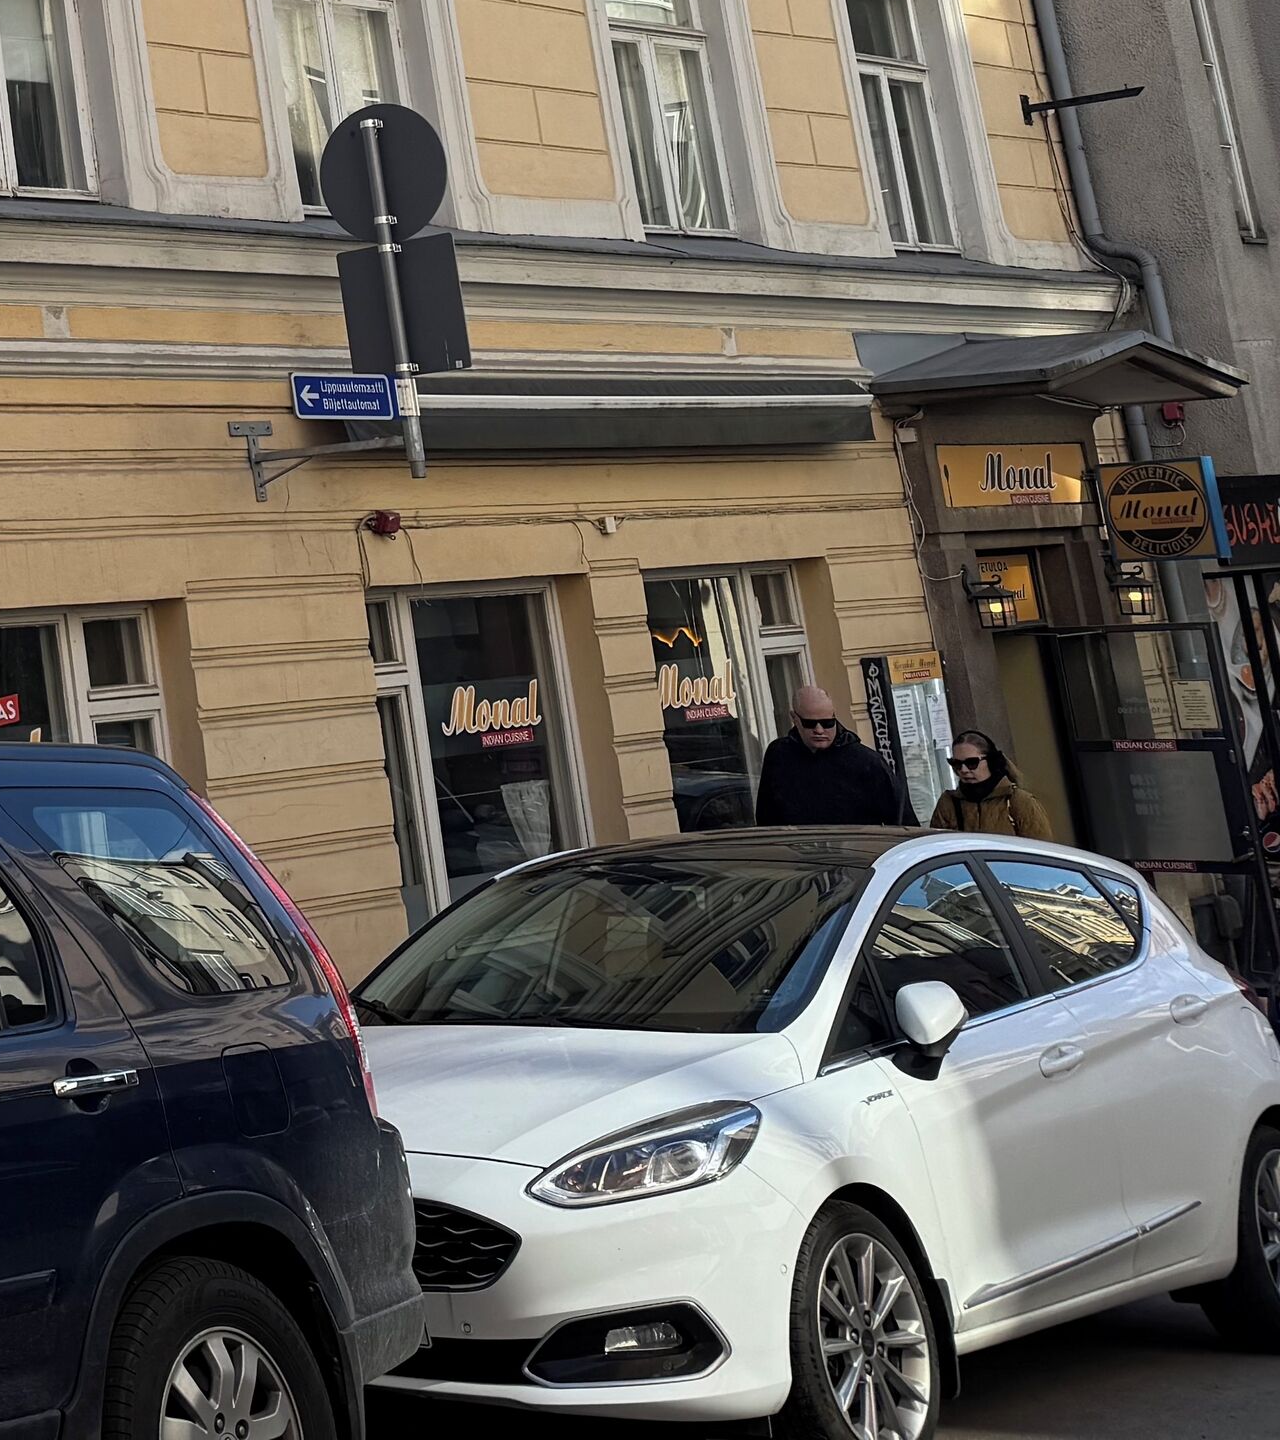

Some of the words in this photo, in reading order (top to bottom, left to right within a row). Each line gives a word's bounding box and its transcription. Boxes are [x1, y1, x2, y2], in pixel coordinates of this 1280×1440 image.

[320, 380, 384, 395] Lippuautomaatti
[322, 398, 381, 412] Biljettautomat
[978, 451, 1057, 492] Monal
[1118, 466, 1186, 490] AUTHENTIC
[1114, 496, 1198, 520] Monal
[1131, 533, 1195, 554] DELICIOUS
[657, 658, 737, 711] Monal
[441, 678, 542, 737] Monal
[1115, 741, 1142, 749] INDIAN
[1143, 741, 1175, 749] CUISINE
[1134, 861, 1162, 869] INDIAN
[1162, 861, 1195, 869] CUISINE
